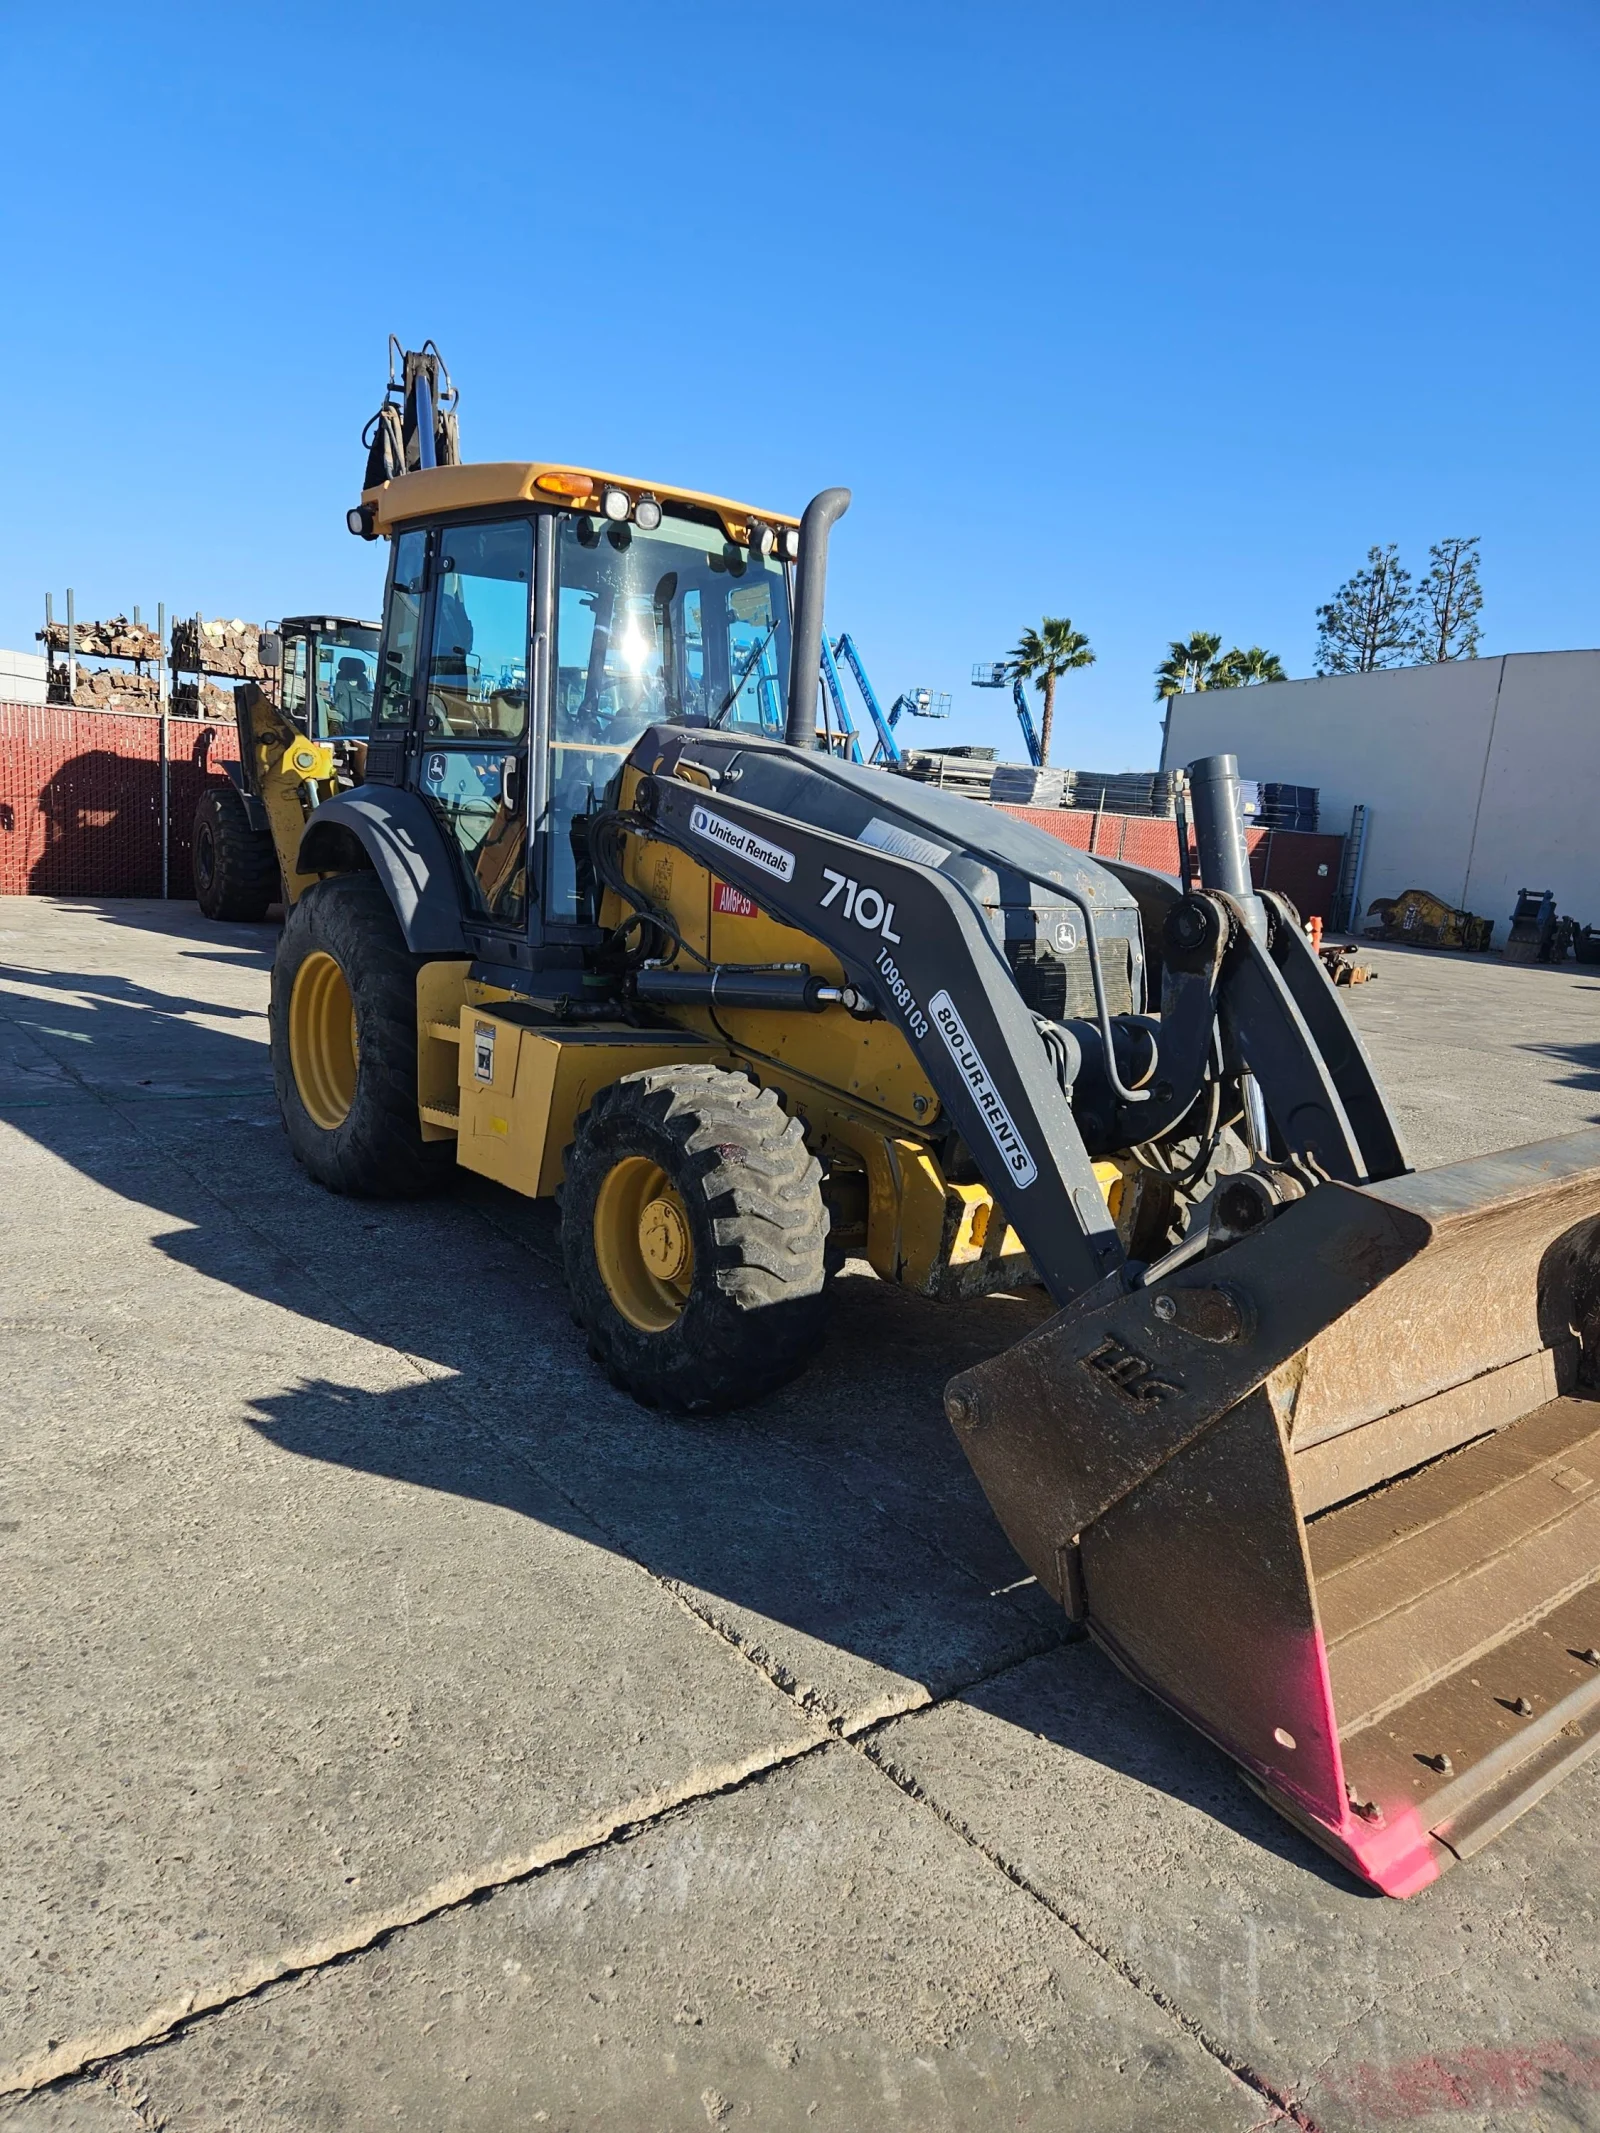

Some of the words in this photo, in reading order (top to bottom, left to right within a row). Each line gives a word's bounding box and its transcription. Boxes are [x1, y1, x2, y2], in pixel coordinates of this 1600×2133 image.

[708, 819, 746, 850] United
[745, 839, 788, 873] Rentals
[820, 868, 900, 945] 710L
[875, 947, 929, 1039] 10968103
[937, 1007, 1028, 1171] 800-UR-RENTS
